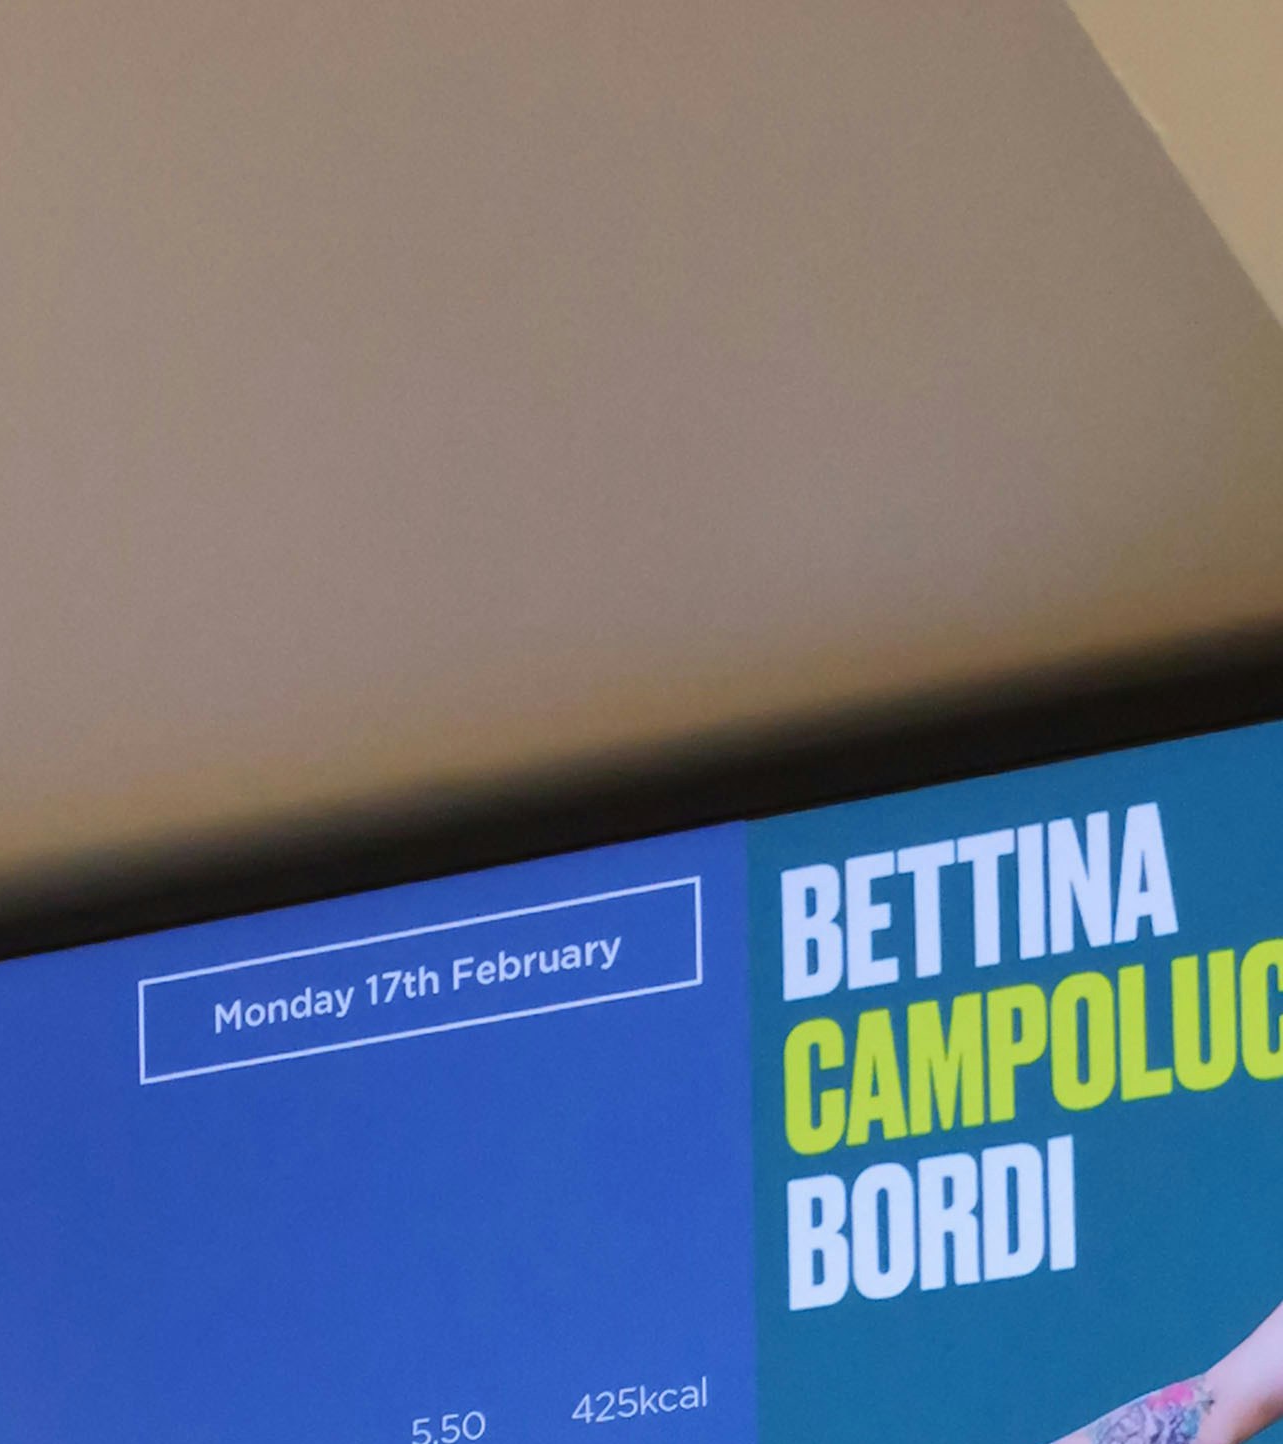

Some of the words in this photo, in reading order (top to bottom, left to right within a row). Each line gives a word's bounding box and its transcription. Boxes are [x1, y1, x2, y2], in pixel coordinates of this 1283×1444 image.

[780, 801, 1179, 1003] BETTINA
[215, 987, 354, 1033] Monday
[366, 966, 439, 1005] 17th
[453, 937, 621, 990] February
[787, 1136, 1076, 1312] BORDI
[572, 1376, 707, 1423] 425kcal
